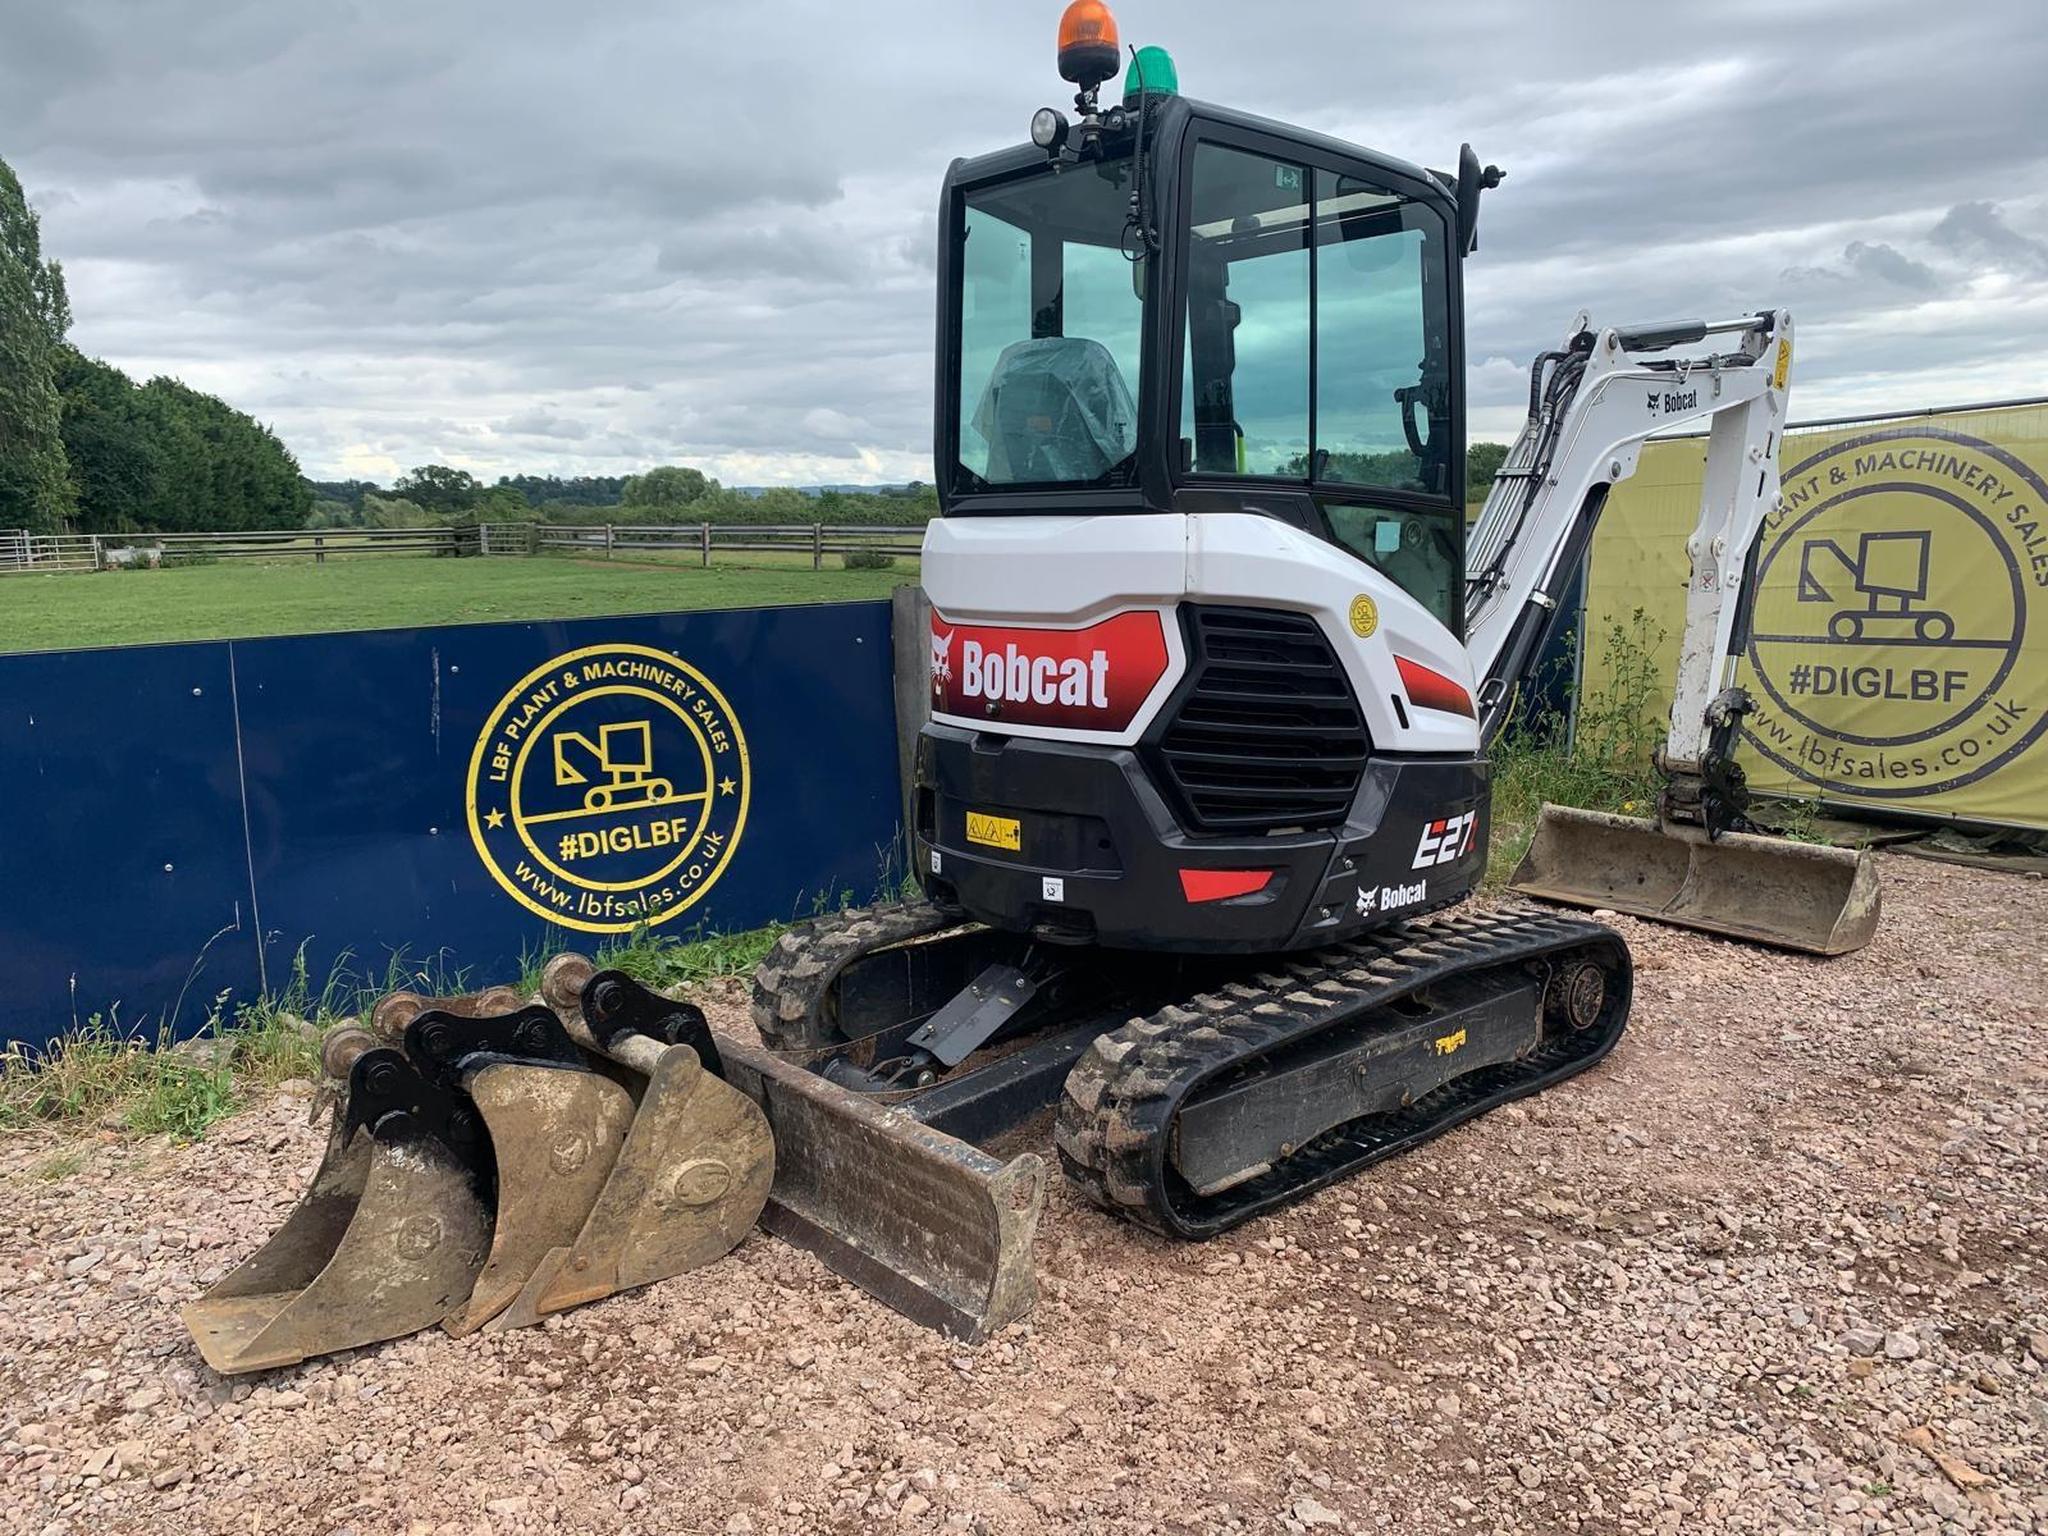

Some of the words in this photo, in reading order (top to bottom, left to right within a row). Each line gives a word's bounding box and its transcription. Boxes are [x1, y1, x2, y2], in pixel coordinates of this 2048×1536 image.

[1664, 389, 1697, 414] Bobcat
[1766, 476, 1820, 530] LANT
[1829, 466, 1848, 485] &
[1854, 449, 2013, 504] MACHINERY
[962, 640, 1110, 709] Bobcat
[1789, 664, 1969, 702] #DIGLBF
[490, 742, 512, 782] LBF
[504, 681, 559, 740] PLANT
[563, 671, 580, 689] &
[582, 660, 698, 702] MACHINERY
[692, 699, 729, 754] SALES
[1743, 685, 2028, 779] ww.lbfsales.co.uk
[515, 830, 724, 917] www.lbfsales.co.uk
[559, 818, 687, 861] #DIGLBF
[1380, 879, 1427, 911] Bobcat
